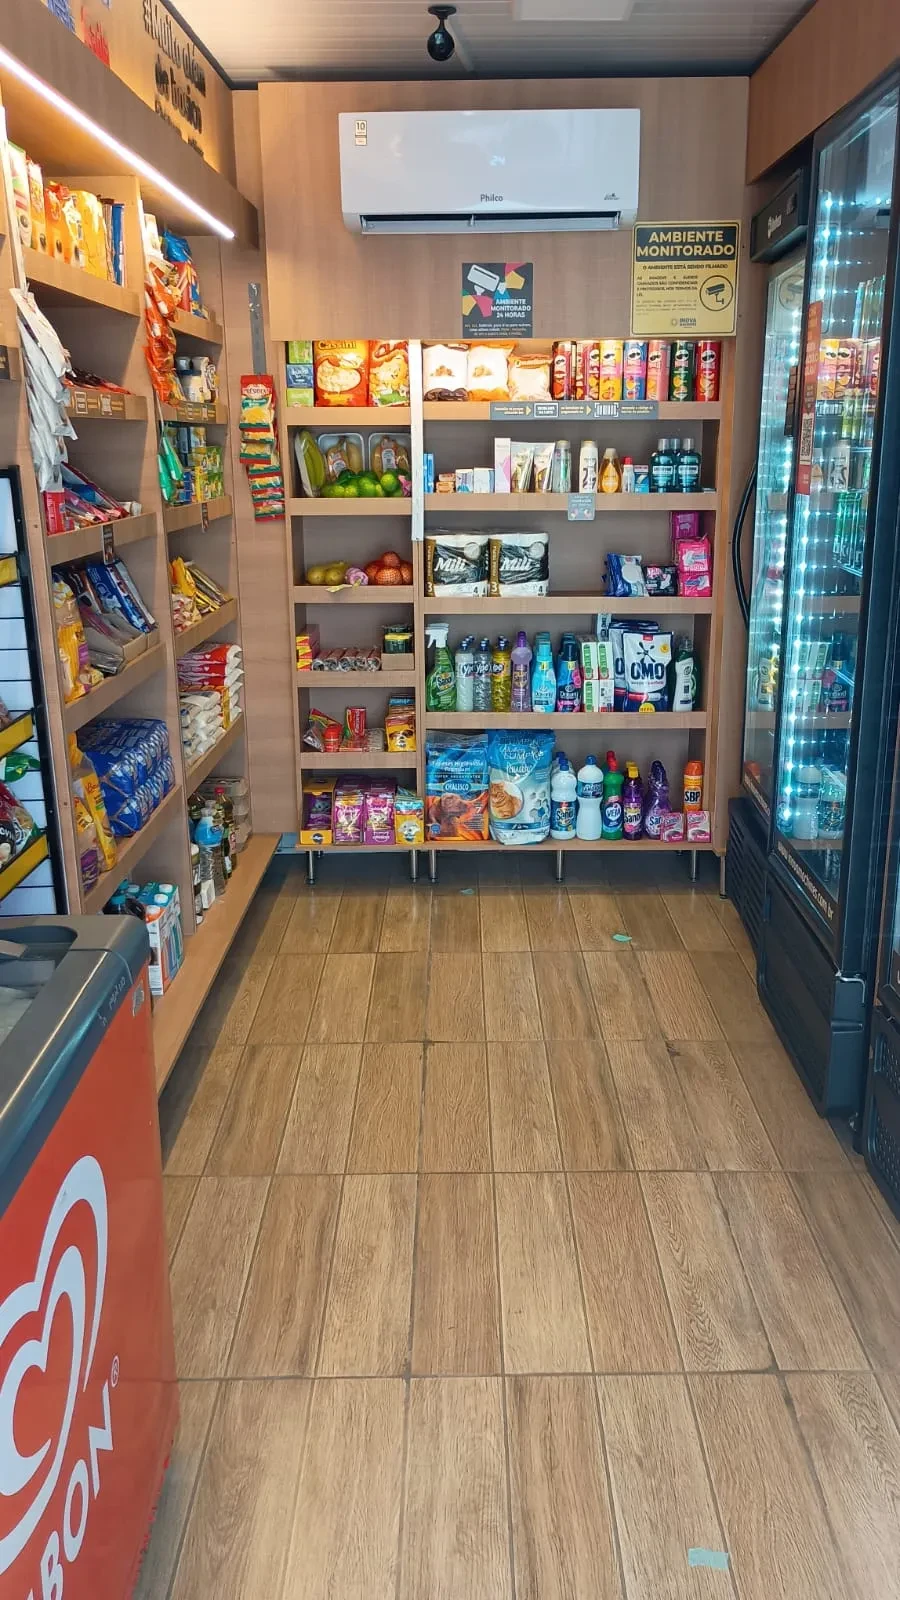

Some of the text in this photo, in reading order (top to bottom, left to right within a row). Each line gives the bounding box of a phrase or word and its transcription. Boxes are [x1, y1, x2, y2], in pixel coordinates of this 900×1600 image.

[480, 193, 504, 203] Philco
[648, 230, 724, 243] AMBIENTE
[636, 244, 735, 257] MONITORADO
[630, 662, 665, 680] OMO
[685, 791, 700, 802] SBP
